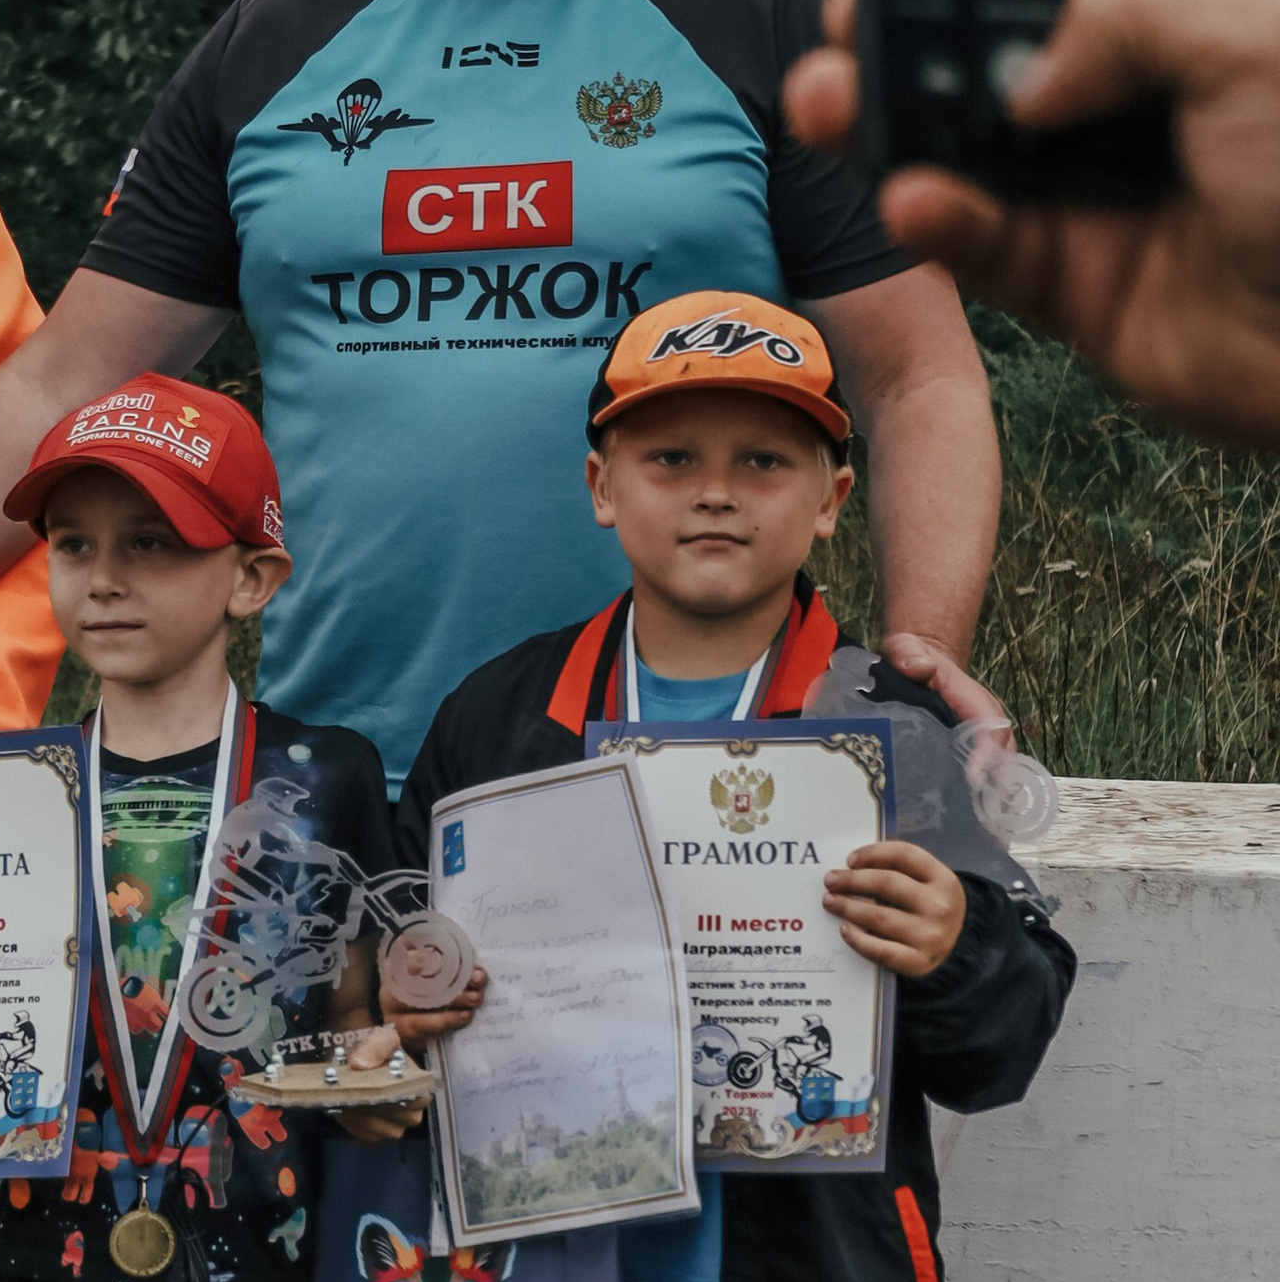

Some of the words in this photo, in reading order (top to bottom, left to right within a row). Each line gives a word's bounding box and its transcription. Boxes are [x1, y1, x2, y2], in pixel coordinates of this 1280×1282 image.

[406, 179, 548, 235] СТК
[310, 260, 653, 325] ТОРЖОК
[336, 337, 440, 355] спортивный
[446, 334, 577, 350] технический
[583, 335, 617, 350] клу
[646, 307, 805, 367] KAYO
[70, 413, 212, 455] RACING
[70, 431, 130, 447] FORMULA
[135, 434, 164, 449] ONE
[168, 444, 203, 469] TEEM
[663, 841, 821, 865] ГРАМОТА
[697, 914, 721, 932] III
[730, 918, 804, 932] место
[688, 981, 735, 990] астник
[739, 979, 765, 990] 3-го
[769, 980, 806, 990] этапа
[28, 994, 41, 1004] по
[691, 995, 754, 1009] Тверской
[758, 996, 812, 1007] области
[816, 998, 832, 1007] по
[699, 1013, 780, 1026] Мотокроссу
[272, 1034, 316, 1057] СТК
[724, 1088, 774, 1101] Торжок
